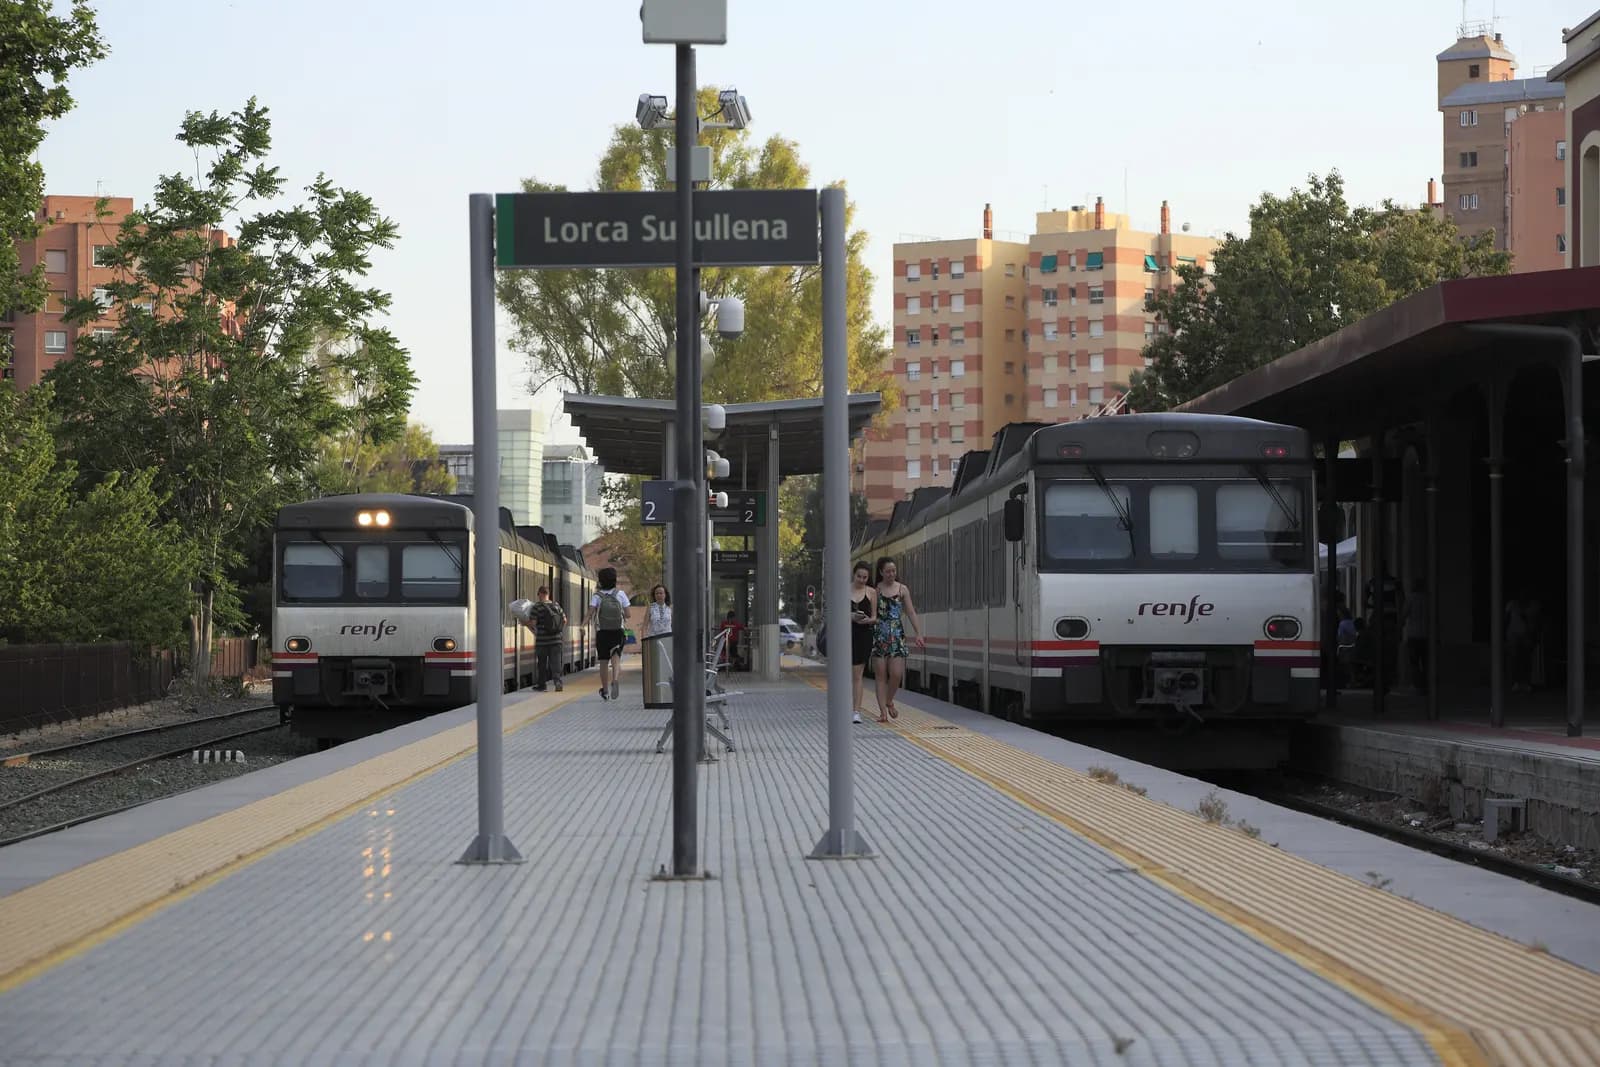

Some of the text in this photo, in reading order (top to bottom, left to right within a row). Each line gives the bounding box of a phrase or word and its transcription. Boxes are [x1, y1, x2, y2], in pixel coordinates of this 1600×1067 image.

[543, 213, 788, 243] Lorca Suullena
[645, 501, 656, 520] 2
[744, 510, 754, 523] 2
[1138, 594, 1215, 625] renfe
[340, 619, 398, 641] renfe
